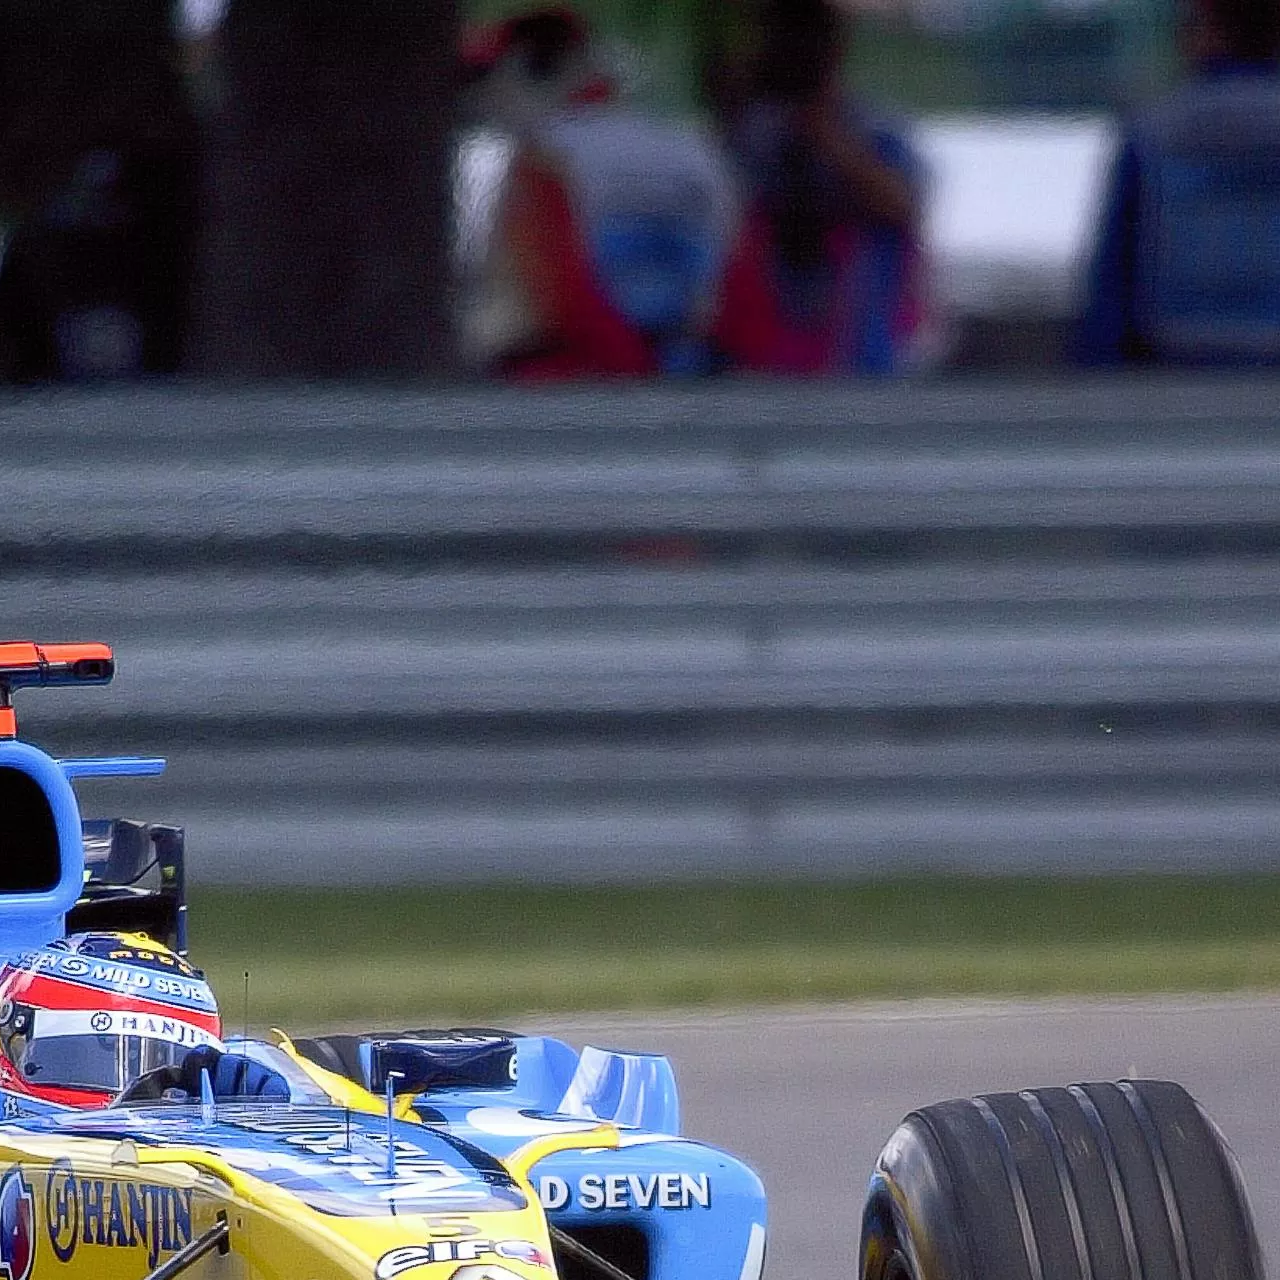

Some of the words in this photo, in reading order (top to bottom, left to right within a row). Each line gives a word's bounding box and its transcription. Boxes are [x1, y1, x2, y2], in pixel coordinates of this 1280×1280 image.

[90, 965, 151, 990] MILD
[578, 1172, 710, 1210] SEVEN
[81, 1179, 194, 1272] HANJIN
